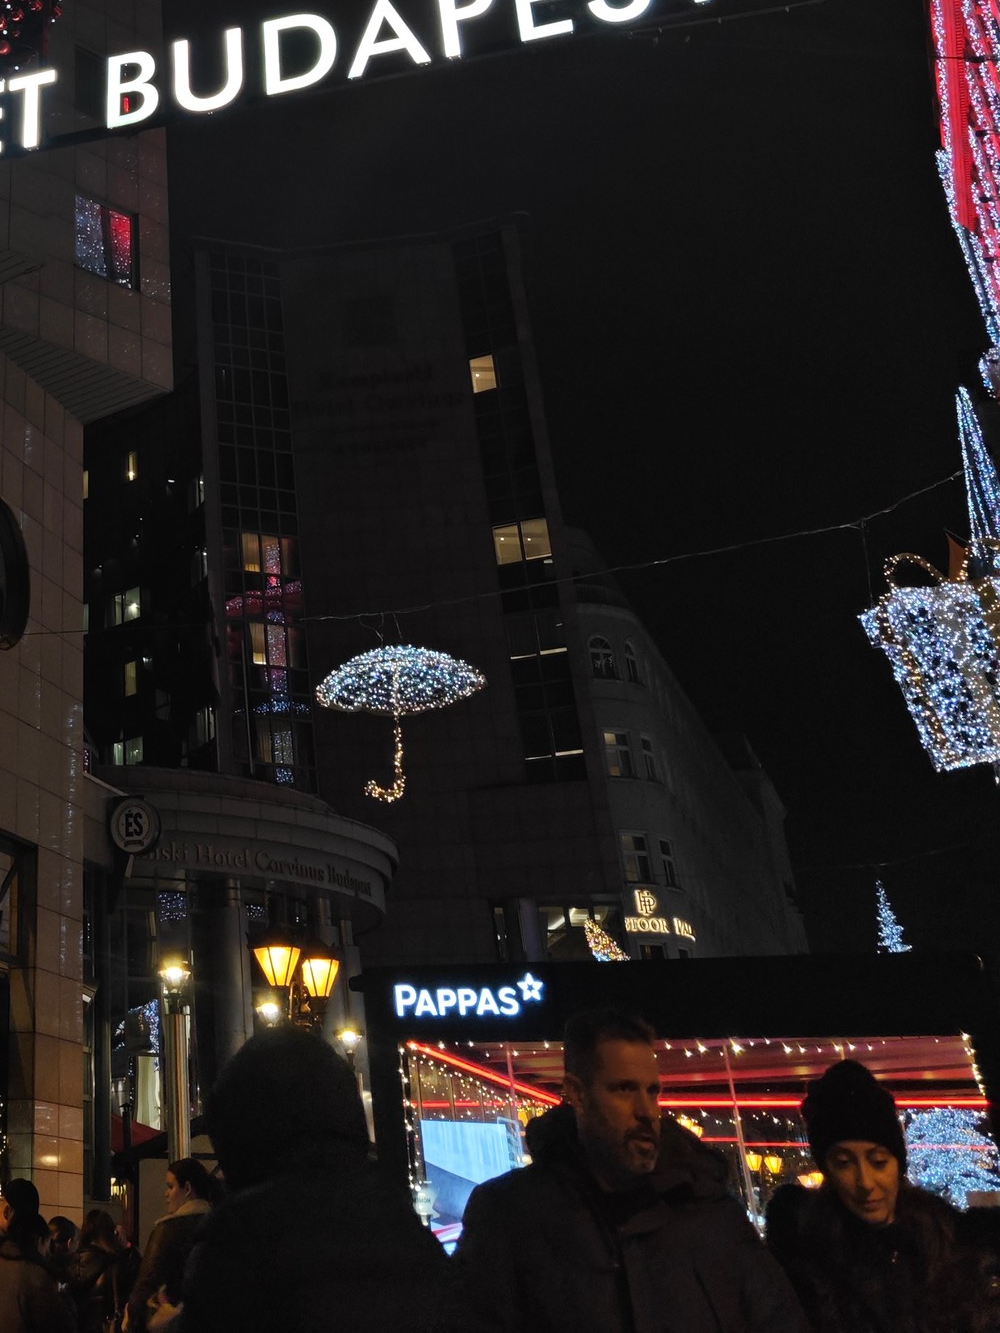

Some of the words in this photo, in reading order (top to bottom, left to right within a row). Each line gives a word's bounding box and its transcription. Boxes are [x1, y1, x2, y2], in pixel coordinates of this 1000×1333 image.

[195, 842, 250, 868] Hotel
[255, 850, 325, 882] Corvinus
[394, 984, 520, 1017] PAPPAS
